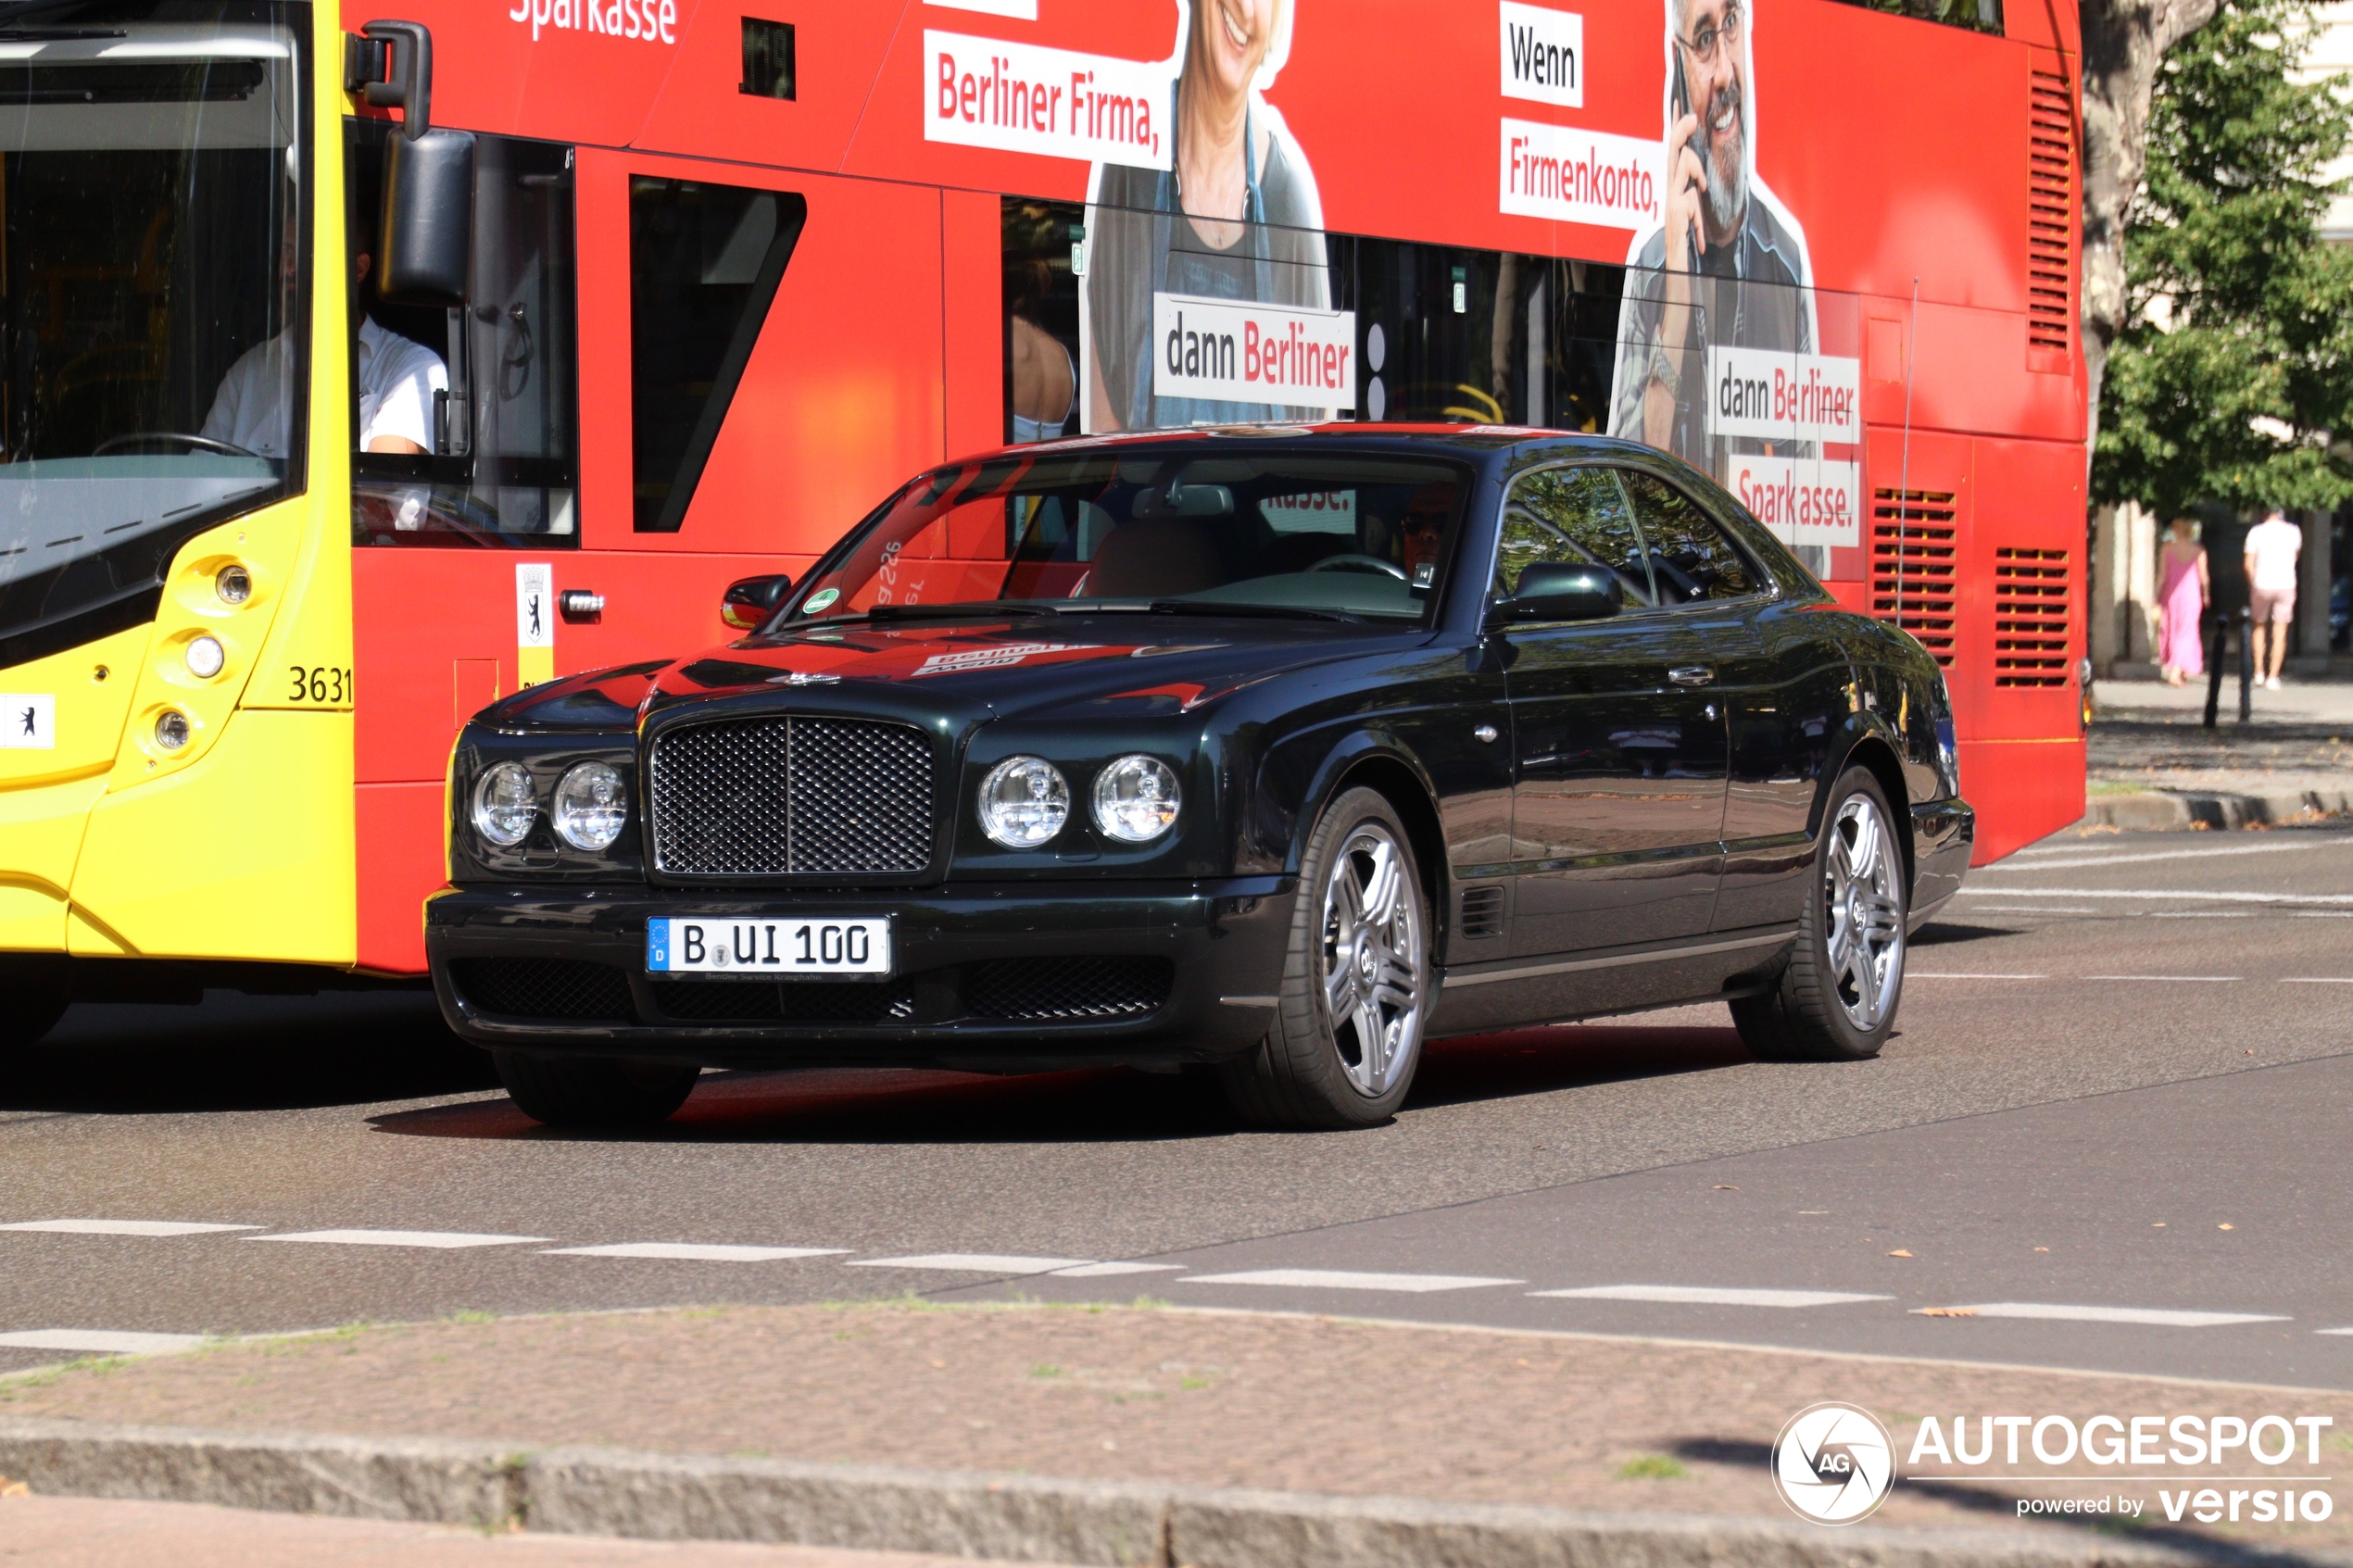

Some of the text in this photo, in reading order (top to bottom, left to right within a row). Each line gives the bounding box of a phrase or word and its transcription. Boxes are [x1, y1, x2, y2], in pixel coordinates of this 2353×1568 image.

[1509, 22, 1575, 89] Wenn
[937, 52, 1159, 158] Berliner Firma,
[1510, 135, 1658, 222] Firmenkonto,
[1166, 310, 1349, 389] dann Berliner
[1719, 360, 1855, 427] dann Berliner
[288, 665, 351, 704] 3631
[655, 950, 664, 961] D
[684, 925, 869, 965] B UI 100
[705, 972, 738, 982] Bentley
[739, 972, 772, 981] Service
